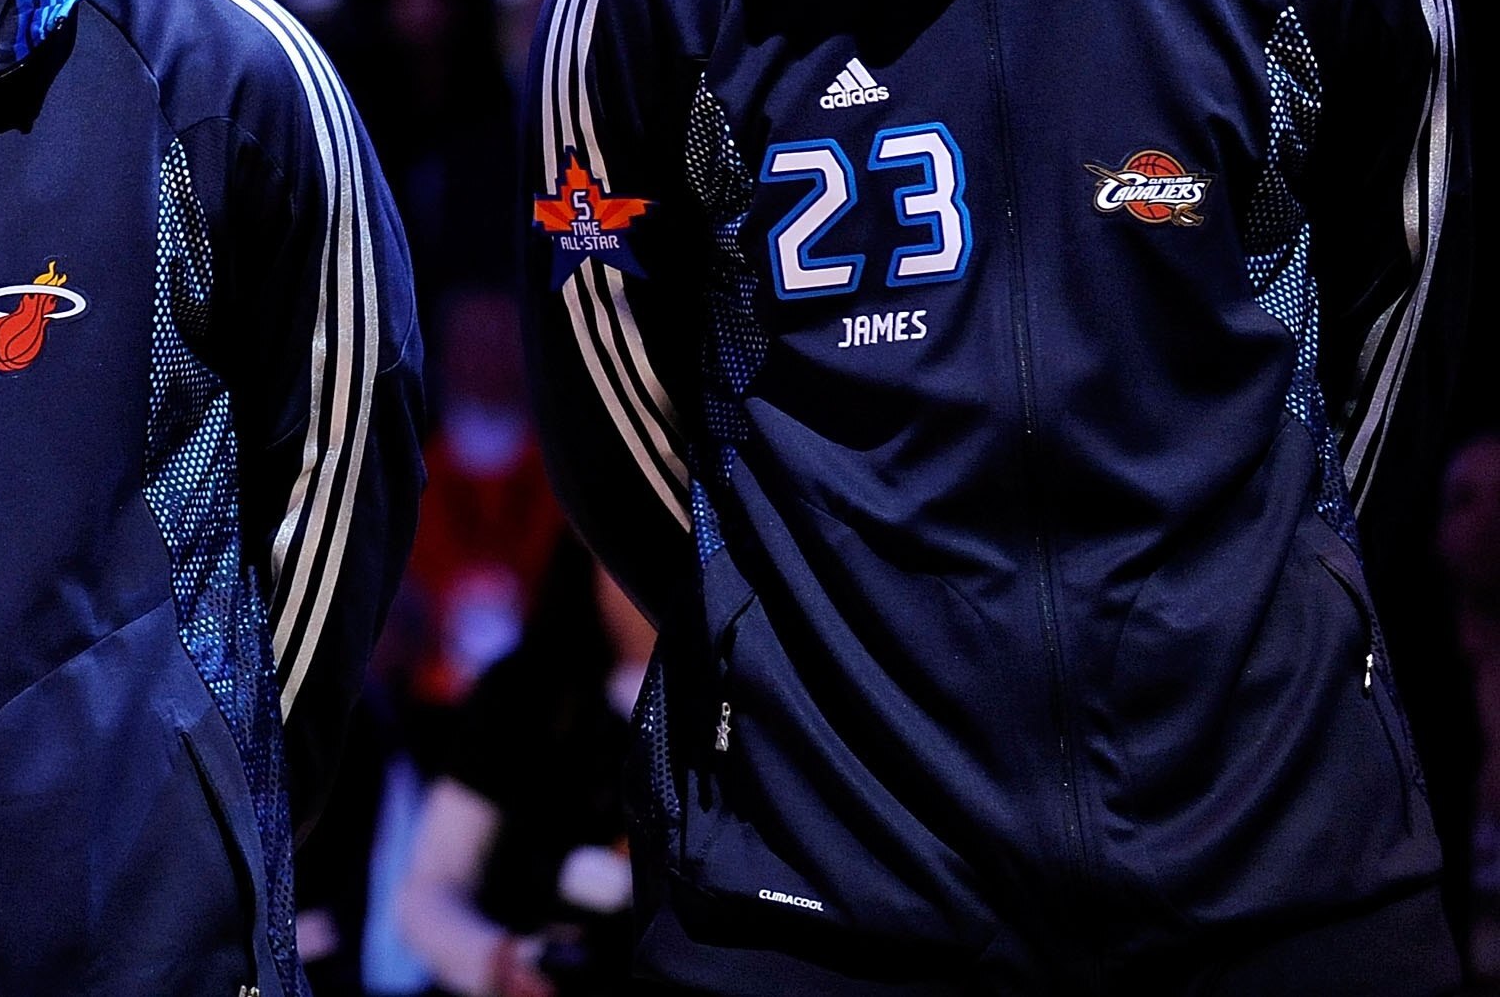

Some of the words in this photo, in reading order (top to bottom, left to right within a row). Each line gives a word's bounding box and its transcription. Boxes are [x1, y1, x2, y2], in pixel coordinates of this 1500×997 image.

[819, 85, 890, 109] adidas
[573, 191, 591, 220] 5
[759, 121, 973, 301] 23
[571, 222, 601, 236] TIME
[838, 310, 927, 348] JAMES
[758, 889, 824, 912] CLIMACOOL
